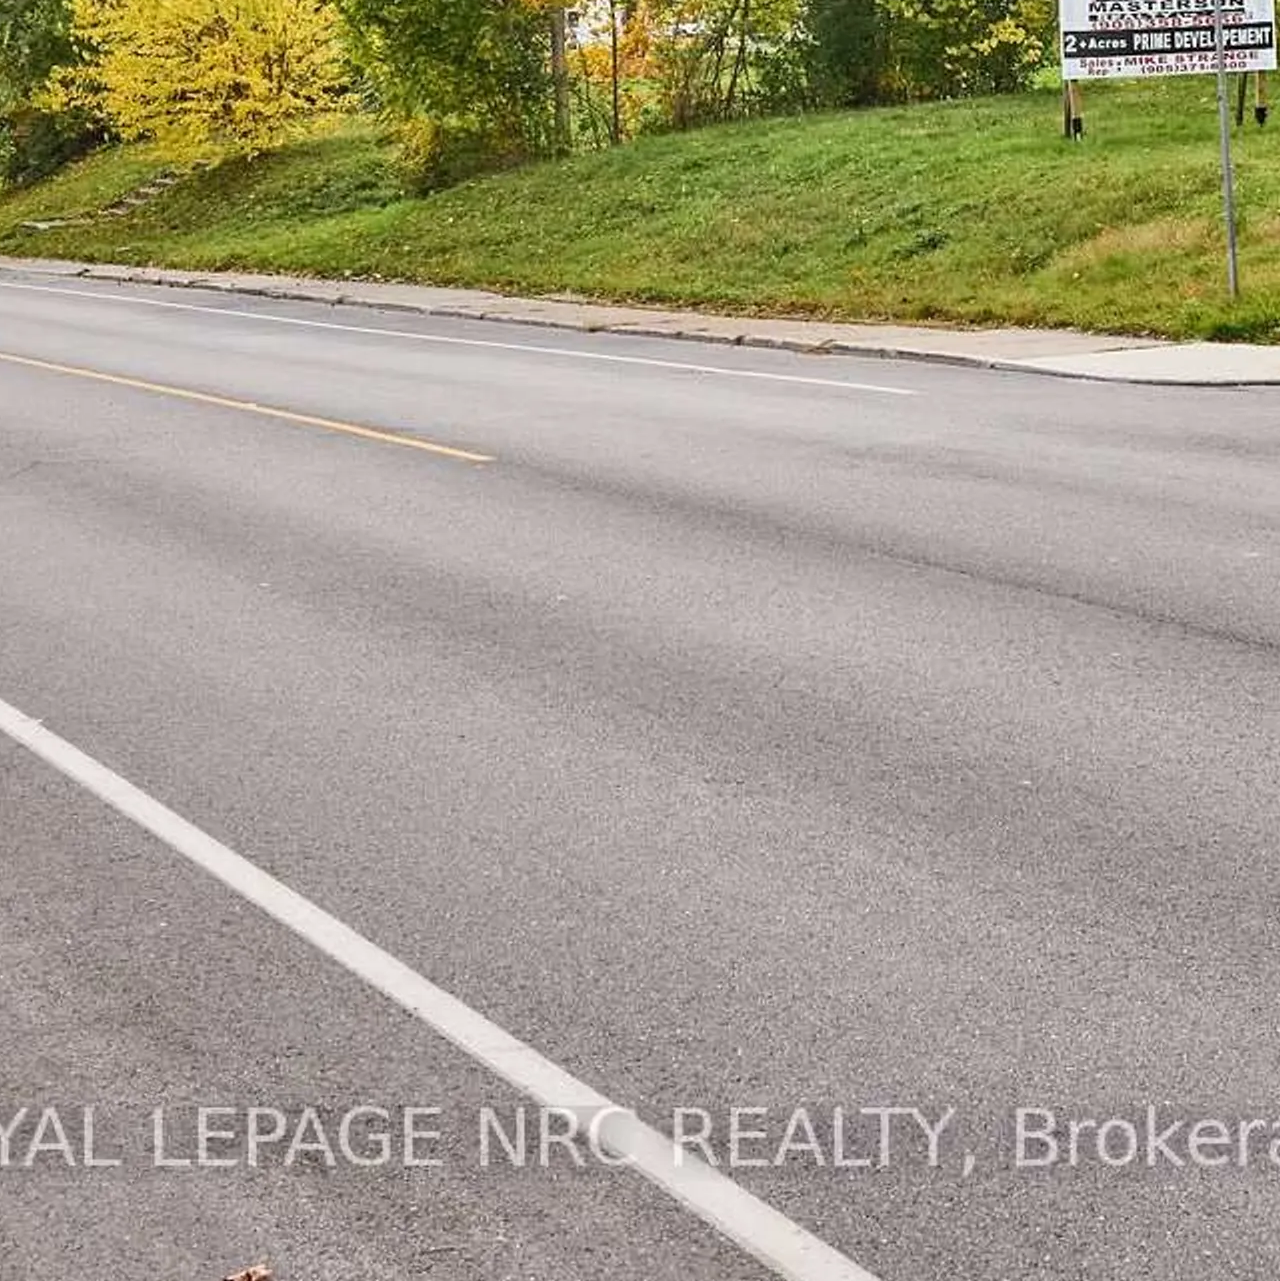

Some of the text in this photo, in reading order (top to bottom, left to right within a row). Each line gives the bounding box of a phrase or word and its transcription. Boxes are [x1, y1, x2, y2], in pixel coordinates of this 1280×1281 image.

[1133, 32, 1172, 50] PRIME
[1174, 26, 1271, 49] DEVELPEMENT
[1079, 50, 1260, 69] Sales MIKE STRANGE
